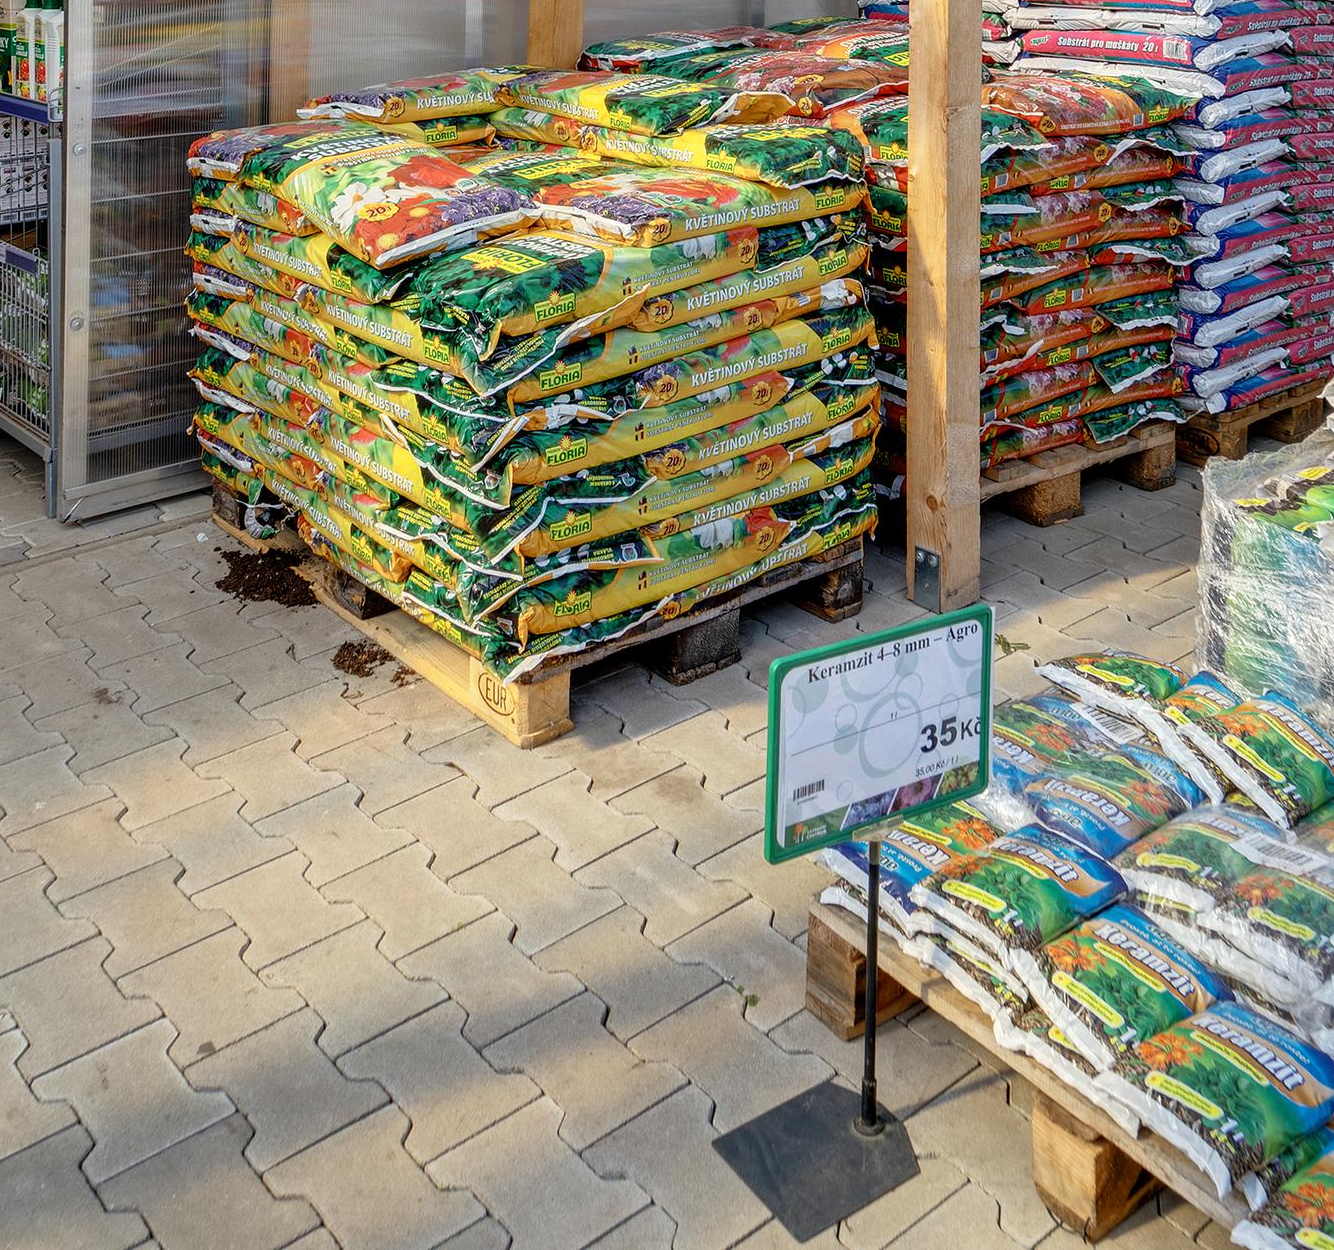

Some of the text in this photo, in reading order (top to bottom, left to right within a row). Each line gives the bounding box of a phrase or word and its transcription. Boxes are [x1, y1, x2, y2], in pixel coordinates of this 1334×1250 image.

[1058, 37, 1154, 52] Substrát pro muškáty 20
[417, 92, 475, 110] KVĚTINOVÝ
[519, 94, 599, 120] KVĚTINOVÝ SUBSTRÁT
[610, 117, 631, 129] FLORIA
[426, 131, 456, 142] FLORIA
[606, 139, 651, 156] KVĚTINOVÝ
[706, 160, 733, 172] FLORIA
[817, 195, 844, 209] FLORIA
[685, 199, 801, 232] KVĚTINOVÝ SUBSTRÁT
[254, 243, 322, 279] KVĚTINOVÝ SUBSTRÁT
[819, 255, 848, 275] FLORIA
[687, 266, 805, 311] KVĚTINOVÝ SUBSTRÁT
[537, 301, 575, 321] FLORIA
[1045, 296, 1066, 307] FLORIA
[326, 304, 413, 348] KVĚTINOVÝ SUBSTRÁT
[822, 334, 850, 350] FLORIA
[424, 348, 449, 363] FLORIA
[692, 342, 808, 388] KVĚTINOVÝ SUBSTRÁT
[1049, 354, 1070, 365] FLORIA
[541, 370, 580, 390] FLORIA
[328, 370, 411, 422] KVĚTINOVÝ SUBSTRÁT
[828, 402, 854, 420] FLORIA
[423, 427, 448, 444] FLORIA
[698, 412, 813, 461] KVĚTINOVÝ SUBSTRÁT
[330, 437, 413, 494] KVĚTINOVÝ SUBSTRÁT
[547, 445, 586, 466] FLORIA
[826, 465, 853, 483] FLORIA
[426, 497, 451, 518] FLORIA
[694, 476, 811, 527] KVĚTINOVÝ SUBSTRÁT
[551, 522, 590, 540] FLORIA
[554, 600, 590, 616] FLORIA
[807, 656, 874, 684] Keramzit
[905, 636, 931, 654] mm
[946, 622, 978, 642] Agro
[485, 678, 506, 711] EUR
[920, 716, 981, 754] 35 Kč
[1044, 779, 1132, 828] Keramzit
[1094, 922, 1196, 998] Keramzit
[1190, 1015, 1305, 1092] Keramzit
